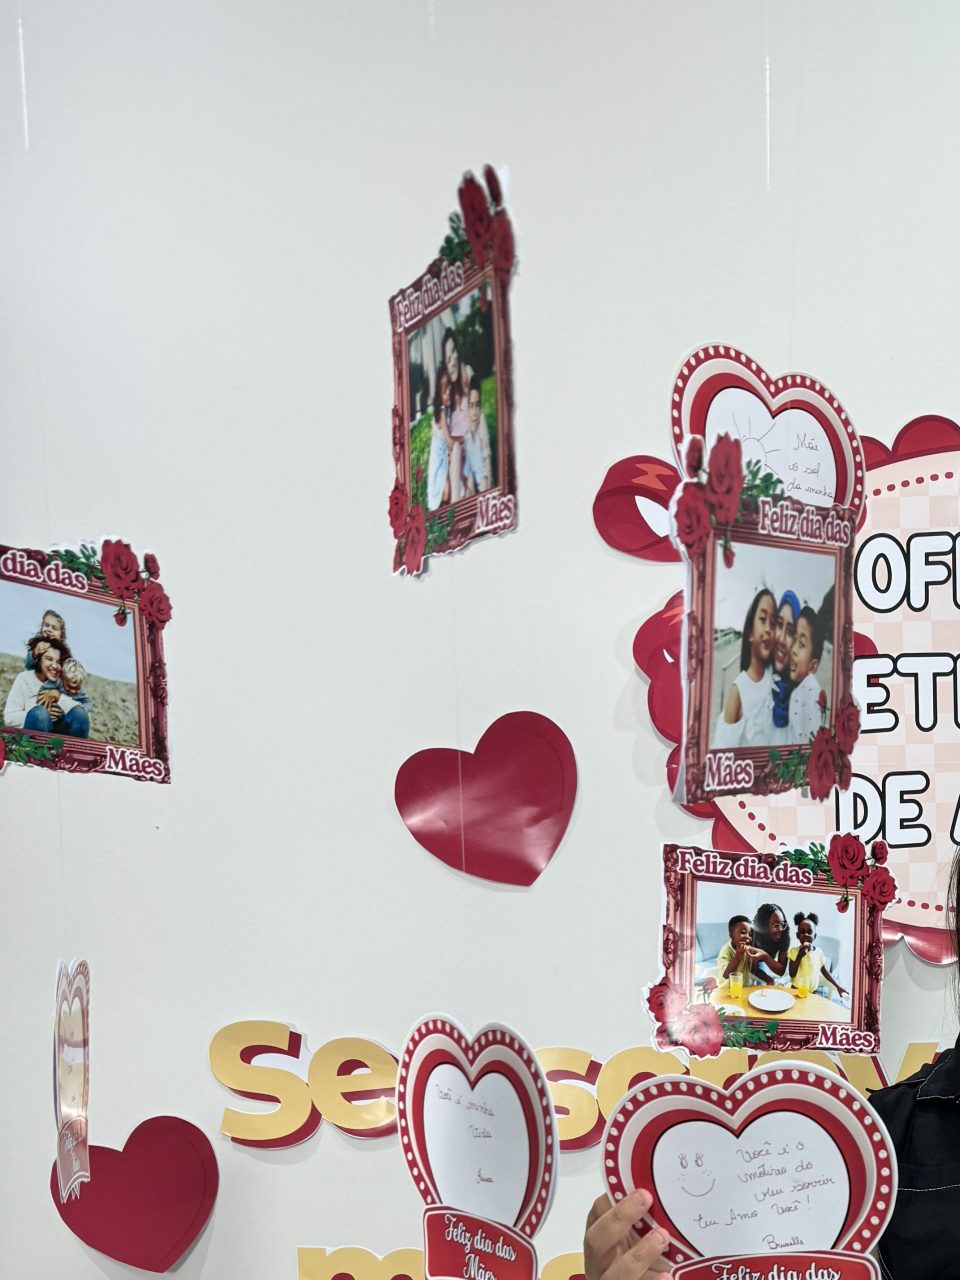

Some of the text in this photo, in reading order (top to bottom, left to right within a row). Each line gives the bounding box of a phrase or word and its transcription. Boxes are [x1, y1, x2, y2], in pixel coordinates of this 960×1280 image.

[760, 499, 850, 545] Feliz dia das
[1, 552, 86, 590] dia das
[107, 748, 164, 777] Mães
[706, 754, 753, 790] Mães
[836, 771, 930, 848] DE
[679, 851, 812, 885] Feliz dia das
[817, 1025, 874, 1048] Mães
[208, 1019, 399, 1150] Se
[444, 1213, 517, 1261] Feliz dia das
